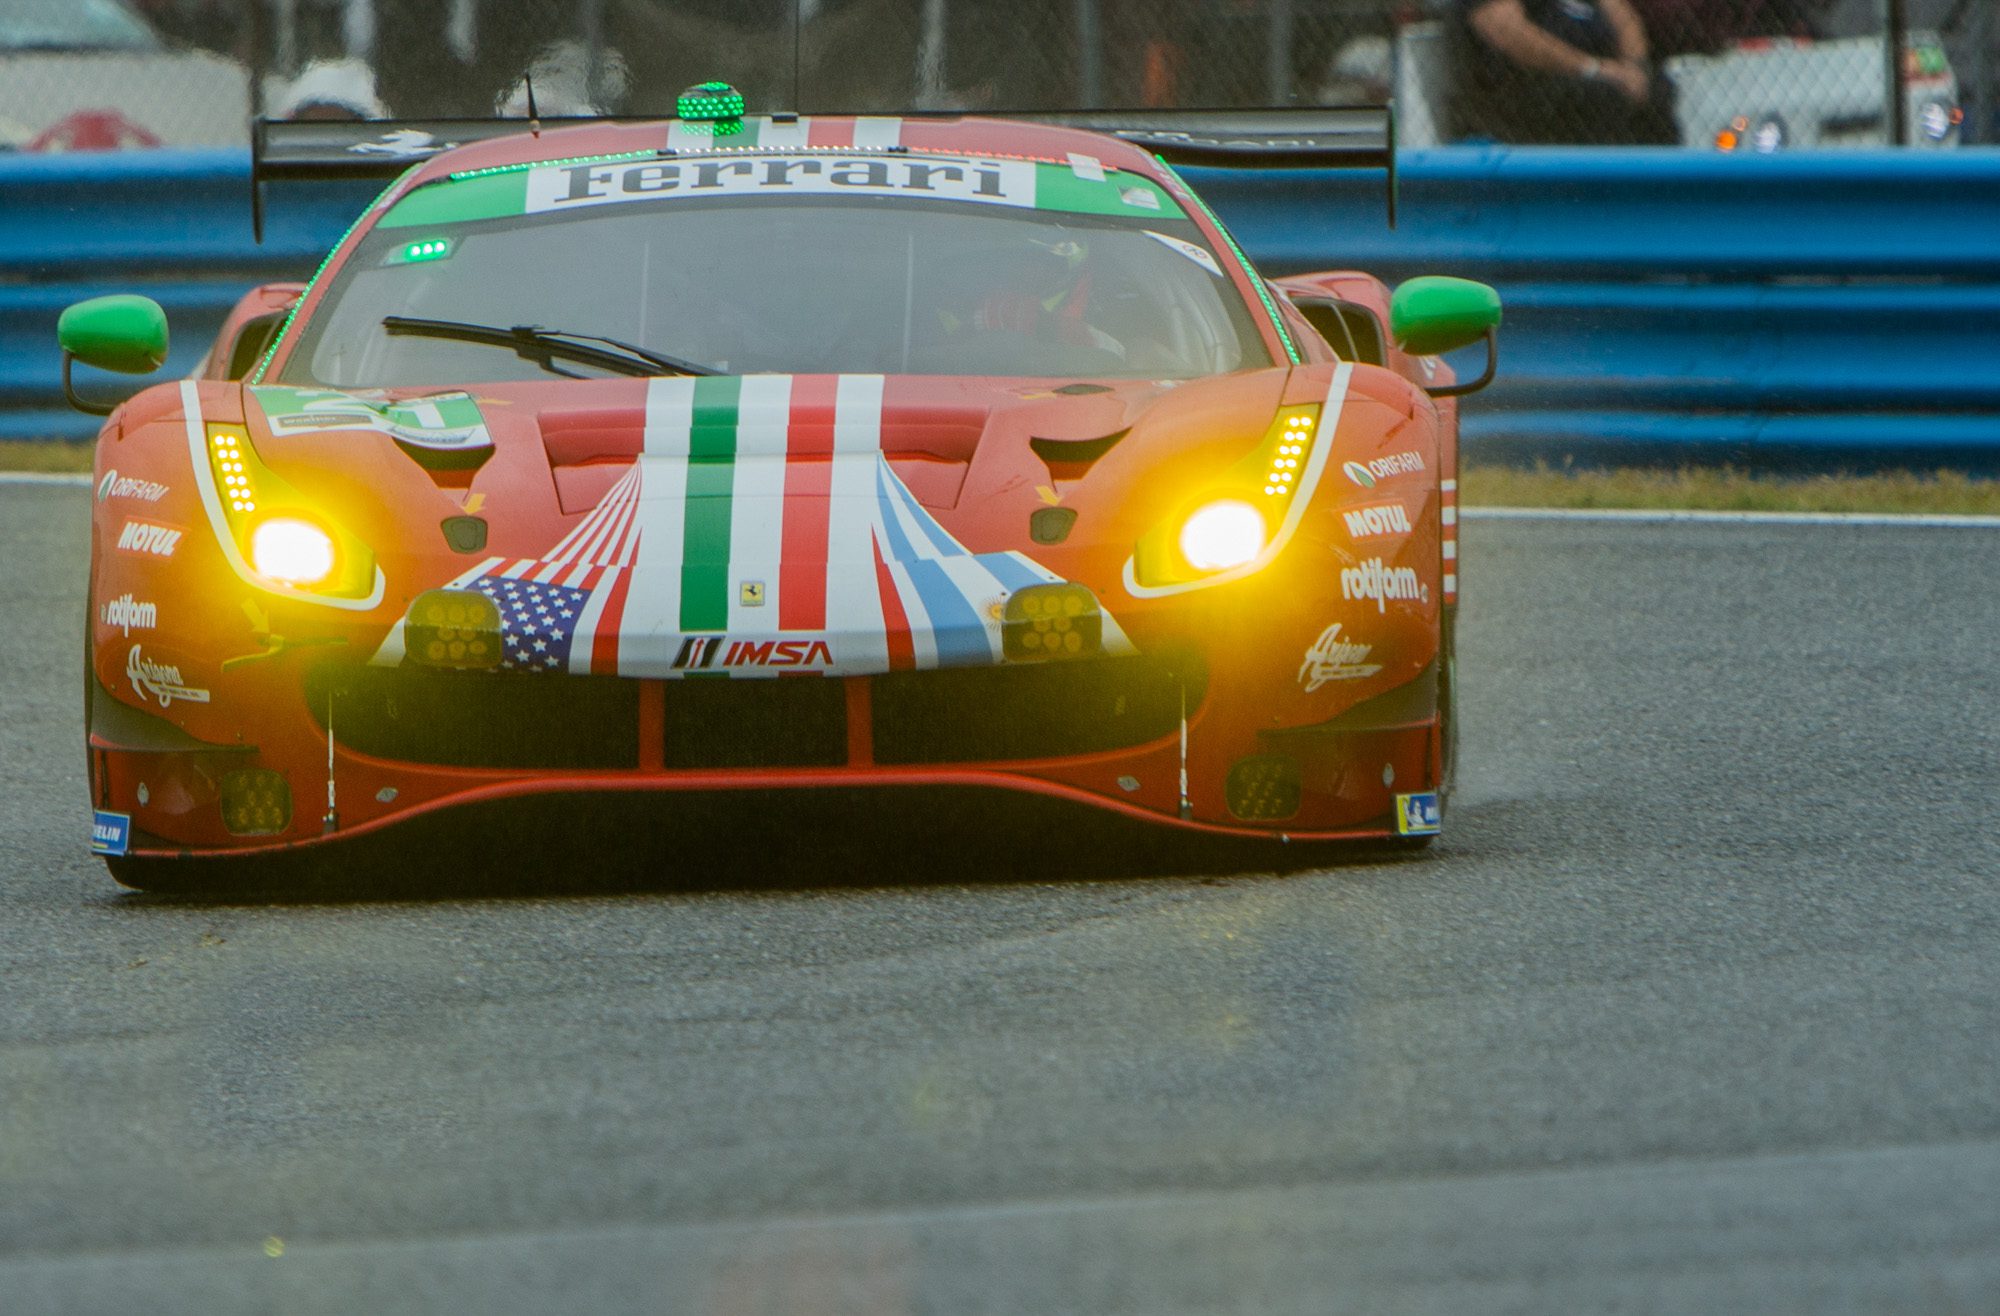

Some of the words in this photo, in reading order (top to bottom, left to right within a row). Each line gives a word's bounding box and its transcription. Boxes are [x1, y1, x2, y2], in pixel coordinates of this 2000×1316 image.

[554, 160, 1007, 203] Ferrari
[1368, 451, 1425, 478] ORIFARM
[111, 477, 170, 502] ORIFARM
[1343, 505, 1412, 537] MOTUL
[117, 521, 182, 556] MOTUL
[1341, 557, 1419, 614] rotiform
[107, 593, 156, 638] rotiform
[723, 641, 833, 665] IMSA
[94, 825, 121, 842] ELIN
